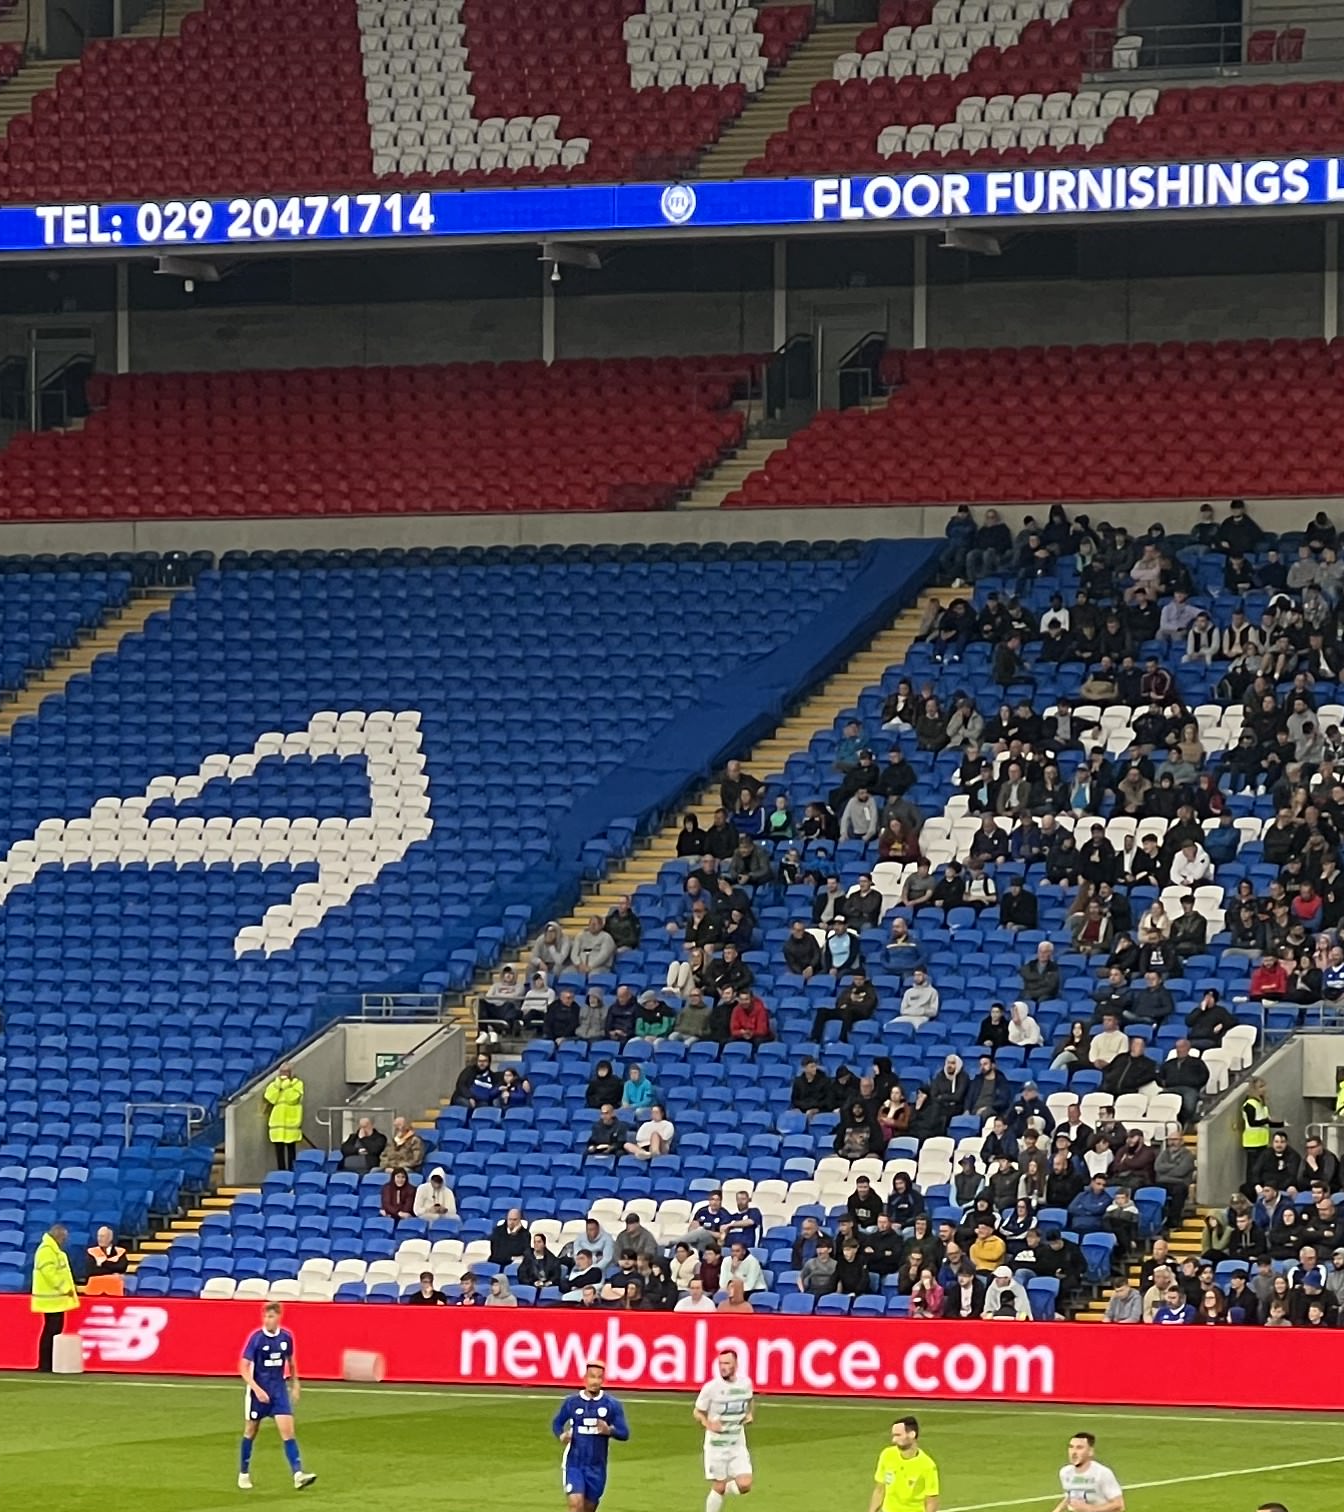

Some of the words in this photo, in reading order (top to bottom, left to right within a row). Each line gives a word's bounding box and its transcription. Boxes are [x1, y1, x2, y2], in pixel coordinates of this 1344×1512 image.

[36, 205, 123, 245] TEL:
[136, 201, 212, 239] 029
[227, 192, 435, 238] 20471714
[813, 173, 971, 220] FLOOR
[987, 159, 1310, 214] FURNISHINGS
[460, 1316, 1055, 1394] newbalance.com
